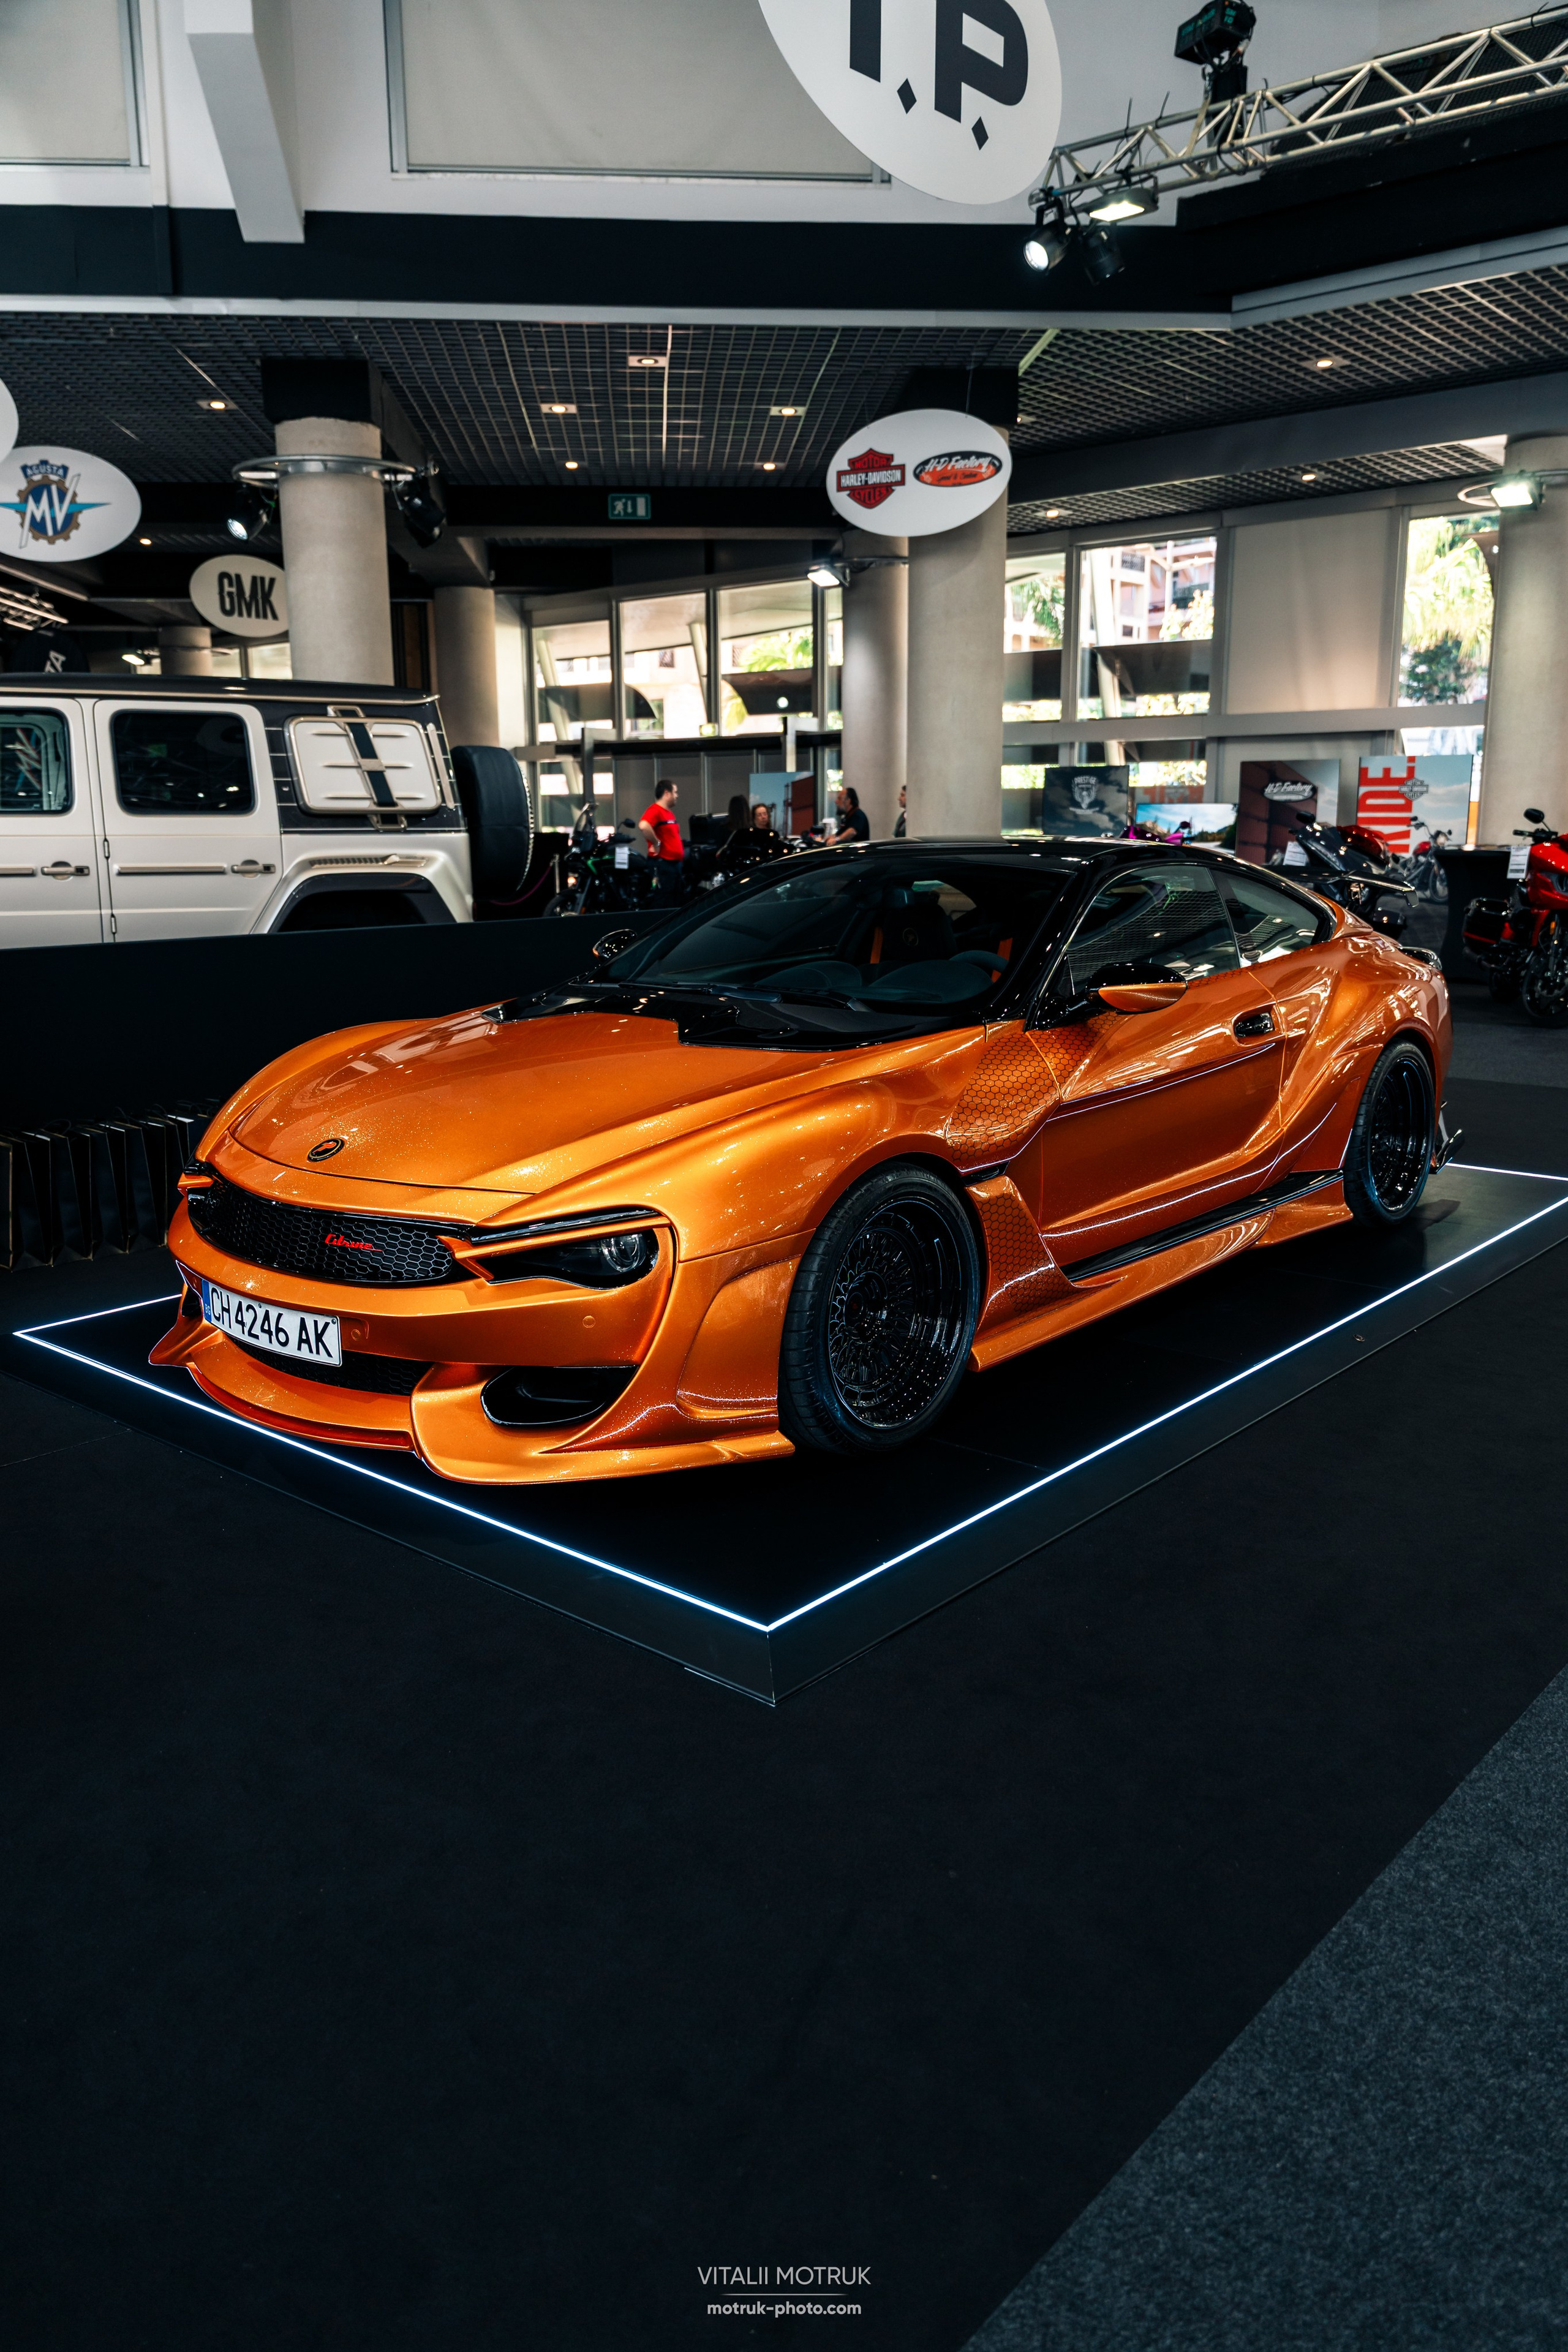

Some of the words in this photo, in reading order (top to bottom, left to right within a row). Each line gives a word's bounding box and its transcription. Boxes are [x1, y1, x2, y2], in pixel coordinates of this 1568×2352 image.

[26, 464, 64, 477] AGUSTA
[854, 454, 888, 469] MOTOR
[948, 455, 993, 473] Factory
[840, 469, 902, 488] HARLEY-DAVIDSON
[19, 473, 81, 549] MV
[217, 571, 279, 621] GMK
[205, 1303, 211, 1316] BG
[211, 1287, 232, 1329] CH
[235, 1300, 290, 1348] 4246
[296, 1317, 333, 1359] AK
